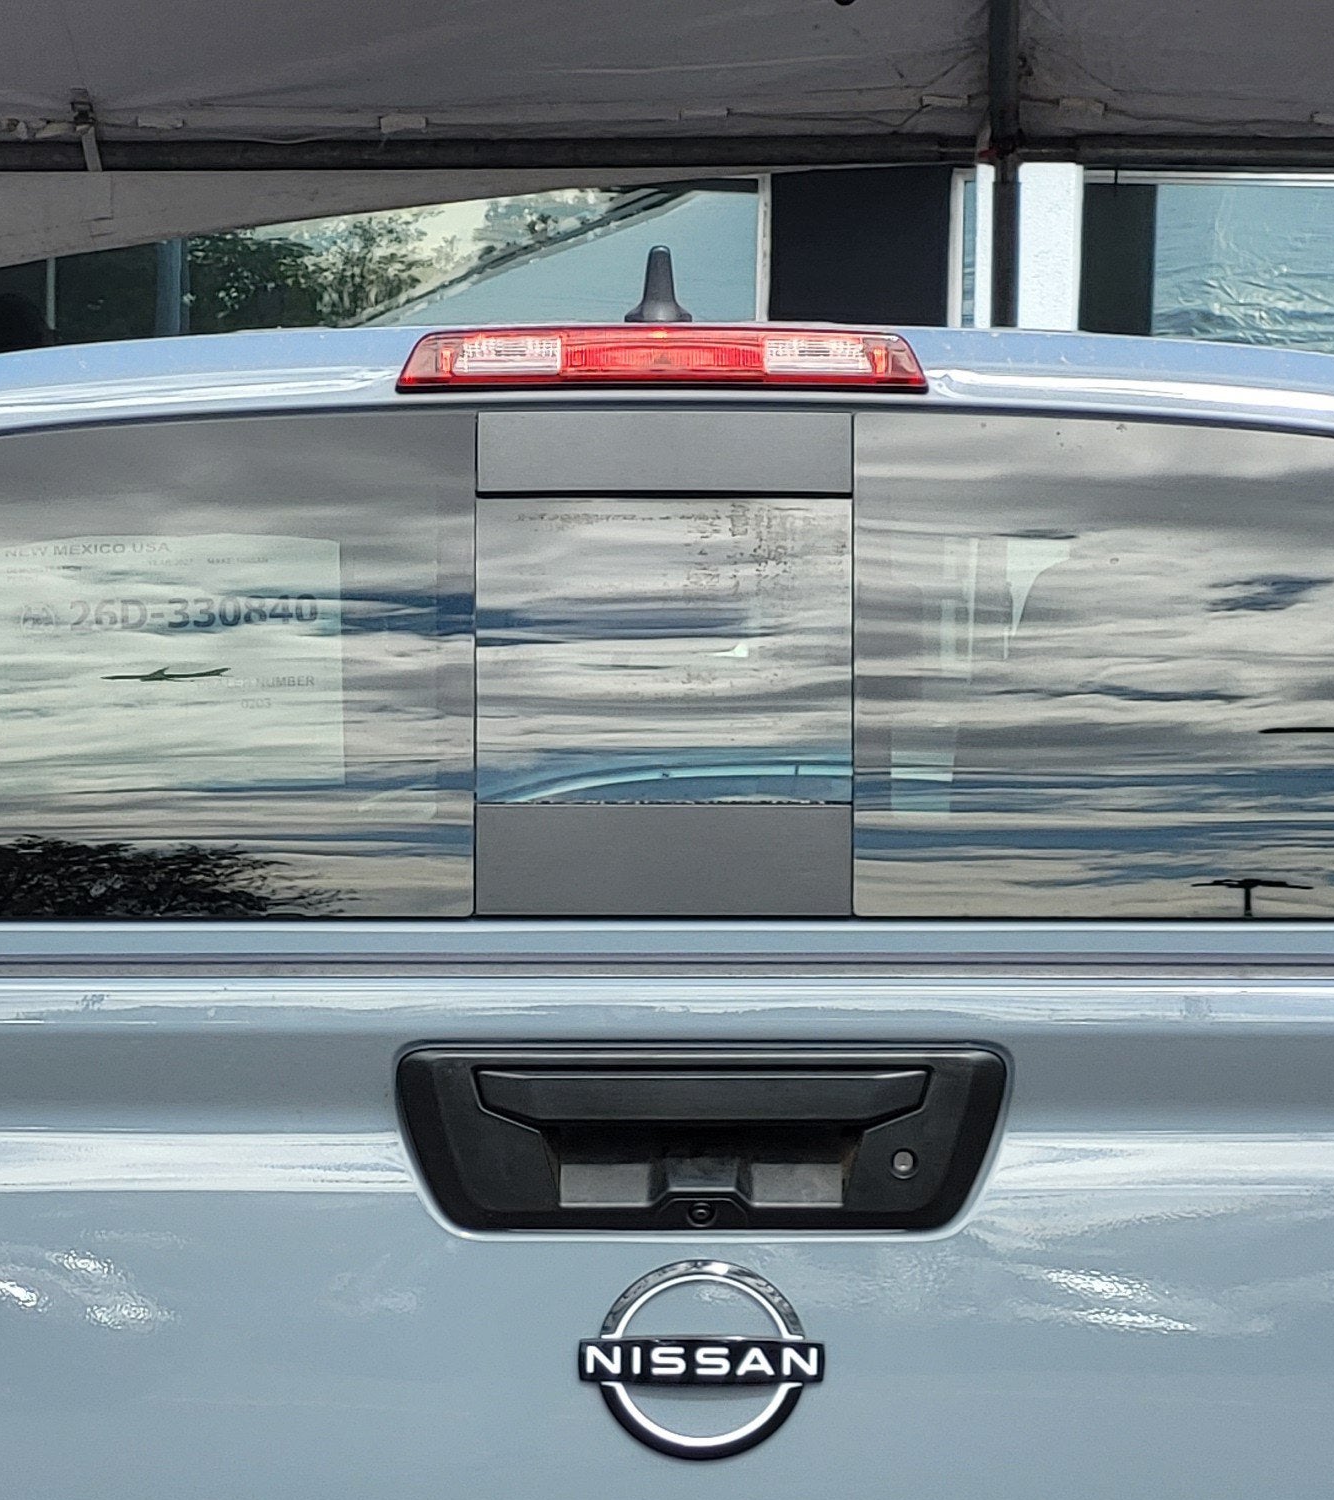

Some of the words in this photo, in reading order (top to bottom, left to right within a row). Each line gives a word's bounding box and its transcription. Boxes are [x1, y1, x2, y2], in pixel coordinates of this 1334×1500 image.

[53, 543, 126, 556] MEXICO
[132, 542, 170, 553] USA
[585, 1345, 819, 1377] NISSAN
